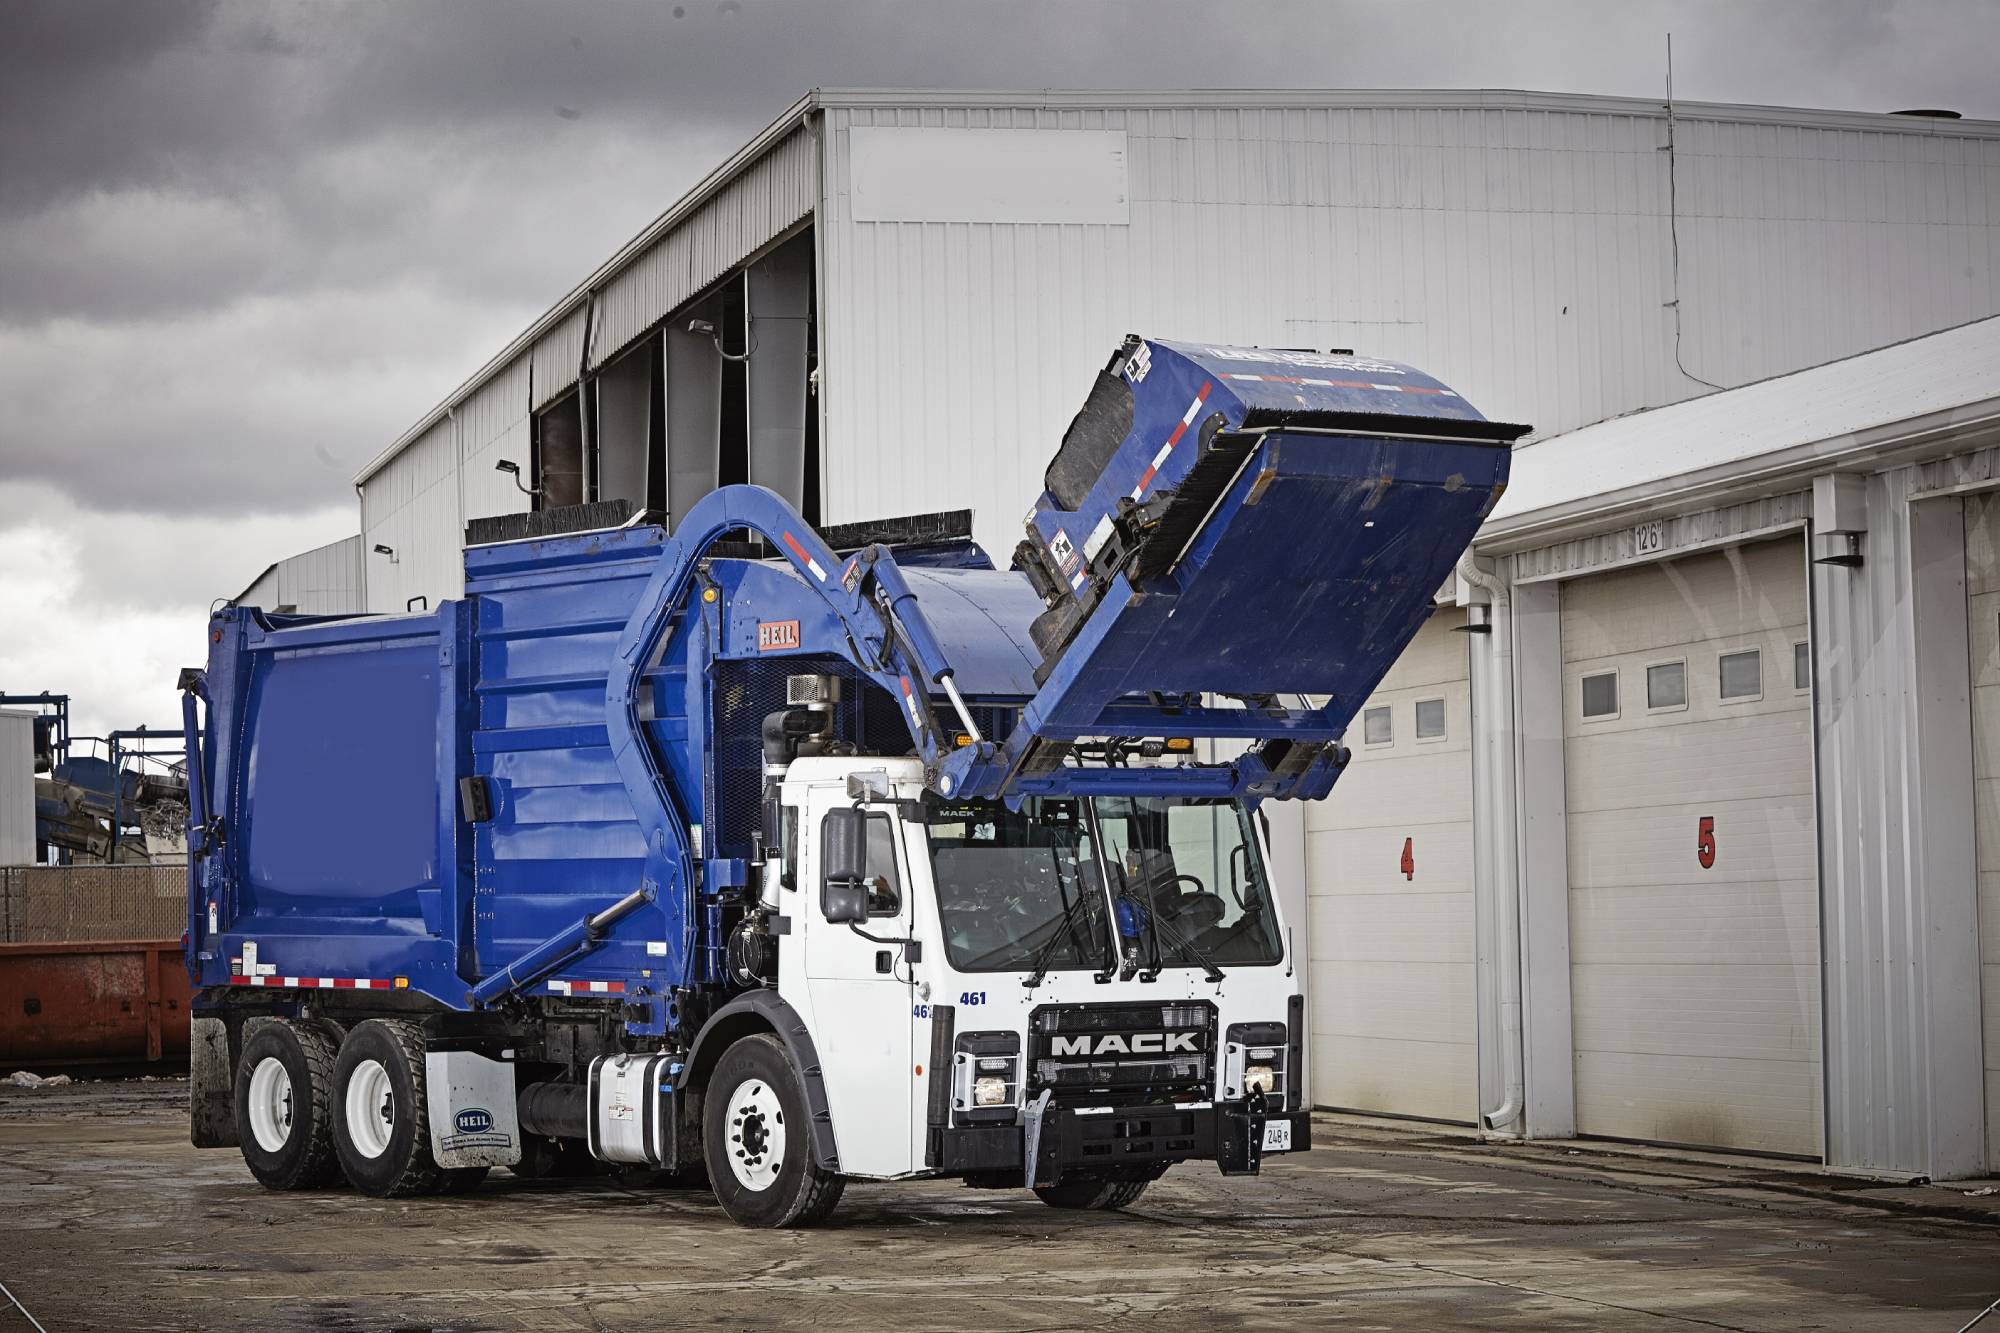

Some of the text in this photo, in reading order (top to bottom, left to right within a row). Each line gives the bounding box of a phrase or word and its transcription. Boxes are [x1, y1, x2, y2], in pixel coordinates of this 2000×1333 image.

[760, 624, 797, 645] HEIL
[1698, 816, 1715, 869] 5
[1401, 837, 1414, 881] 4
[960, 991, 986, 1005] 461
[1052, 1033, 1199, 1056] MACK
[459, 1115, 489, 1127] HEIL
